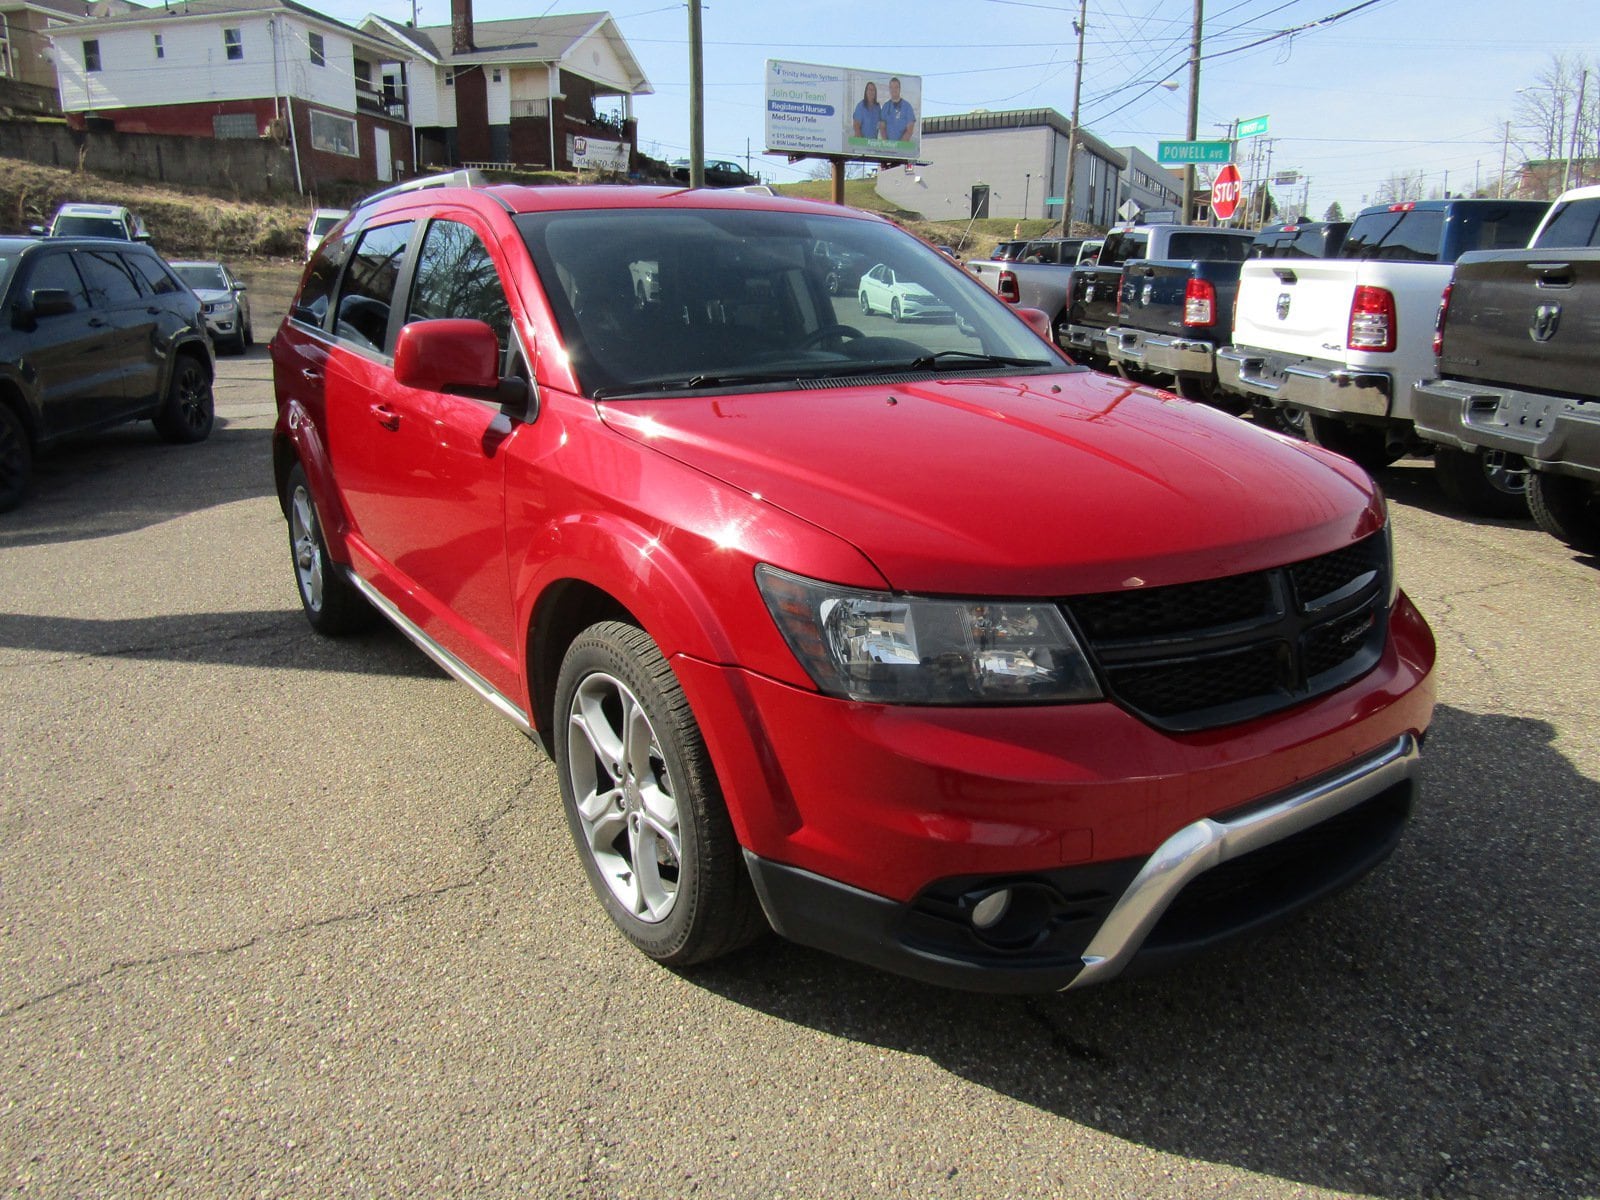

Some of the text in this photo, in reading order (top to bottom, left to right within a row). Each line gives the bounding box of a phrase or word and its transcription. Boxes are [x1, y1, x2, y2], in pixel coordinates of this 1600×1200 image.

[782, 70, 799, 78] Trinity
[800, 71, 818, 79] Health
[772, 88, 826, 101] Join Our Team!
[772, 102, 826, 114] Registered Nurses
[786, 115, 800, 124] Surg
[1164, 146, 1223, 159] POWELL AVE
[1214, 181, 1240, 203] STOP
